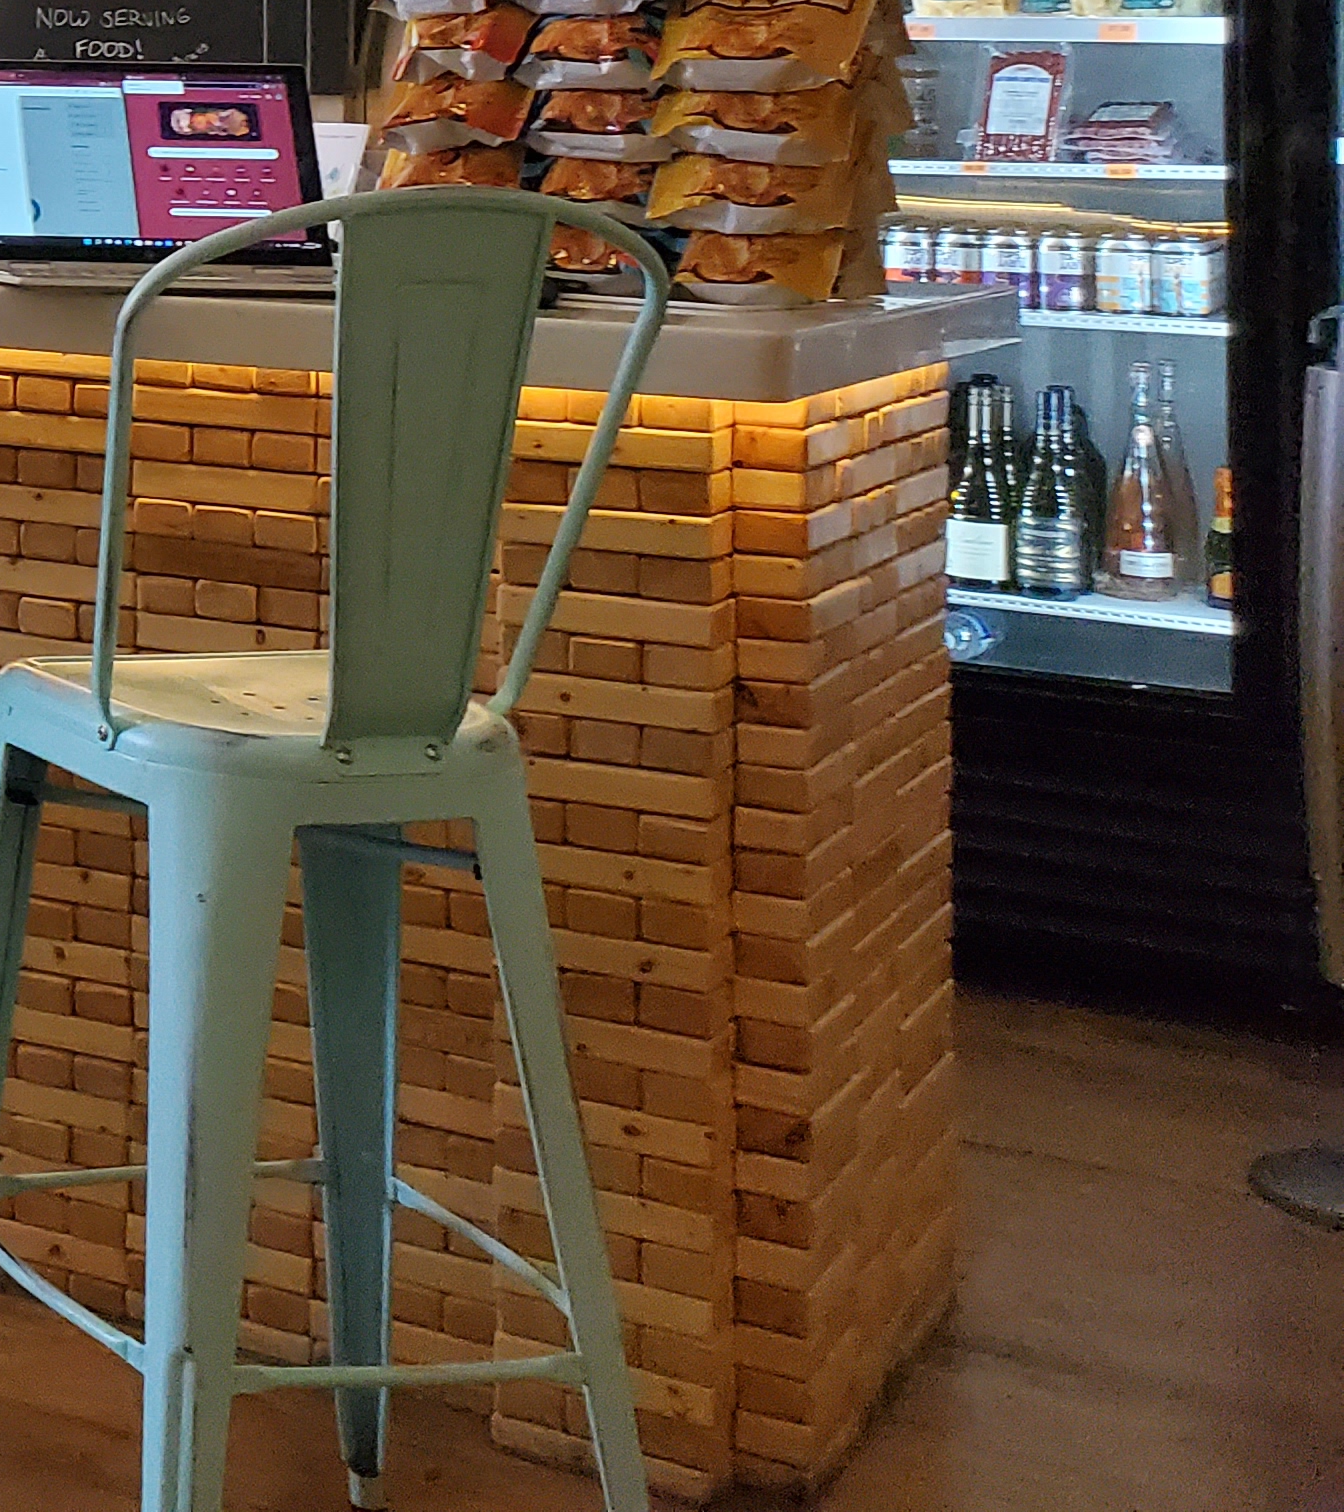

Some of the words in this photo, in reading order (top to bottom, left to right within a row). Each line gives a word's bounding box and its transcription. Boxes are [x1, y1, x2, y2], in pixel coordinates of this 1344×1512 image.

[35, 5, 91, 29] NOW
[99, 7, 192, 29] SERVING
[74, 39, 145, 60] FOOD!
